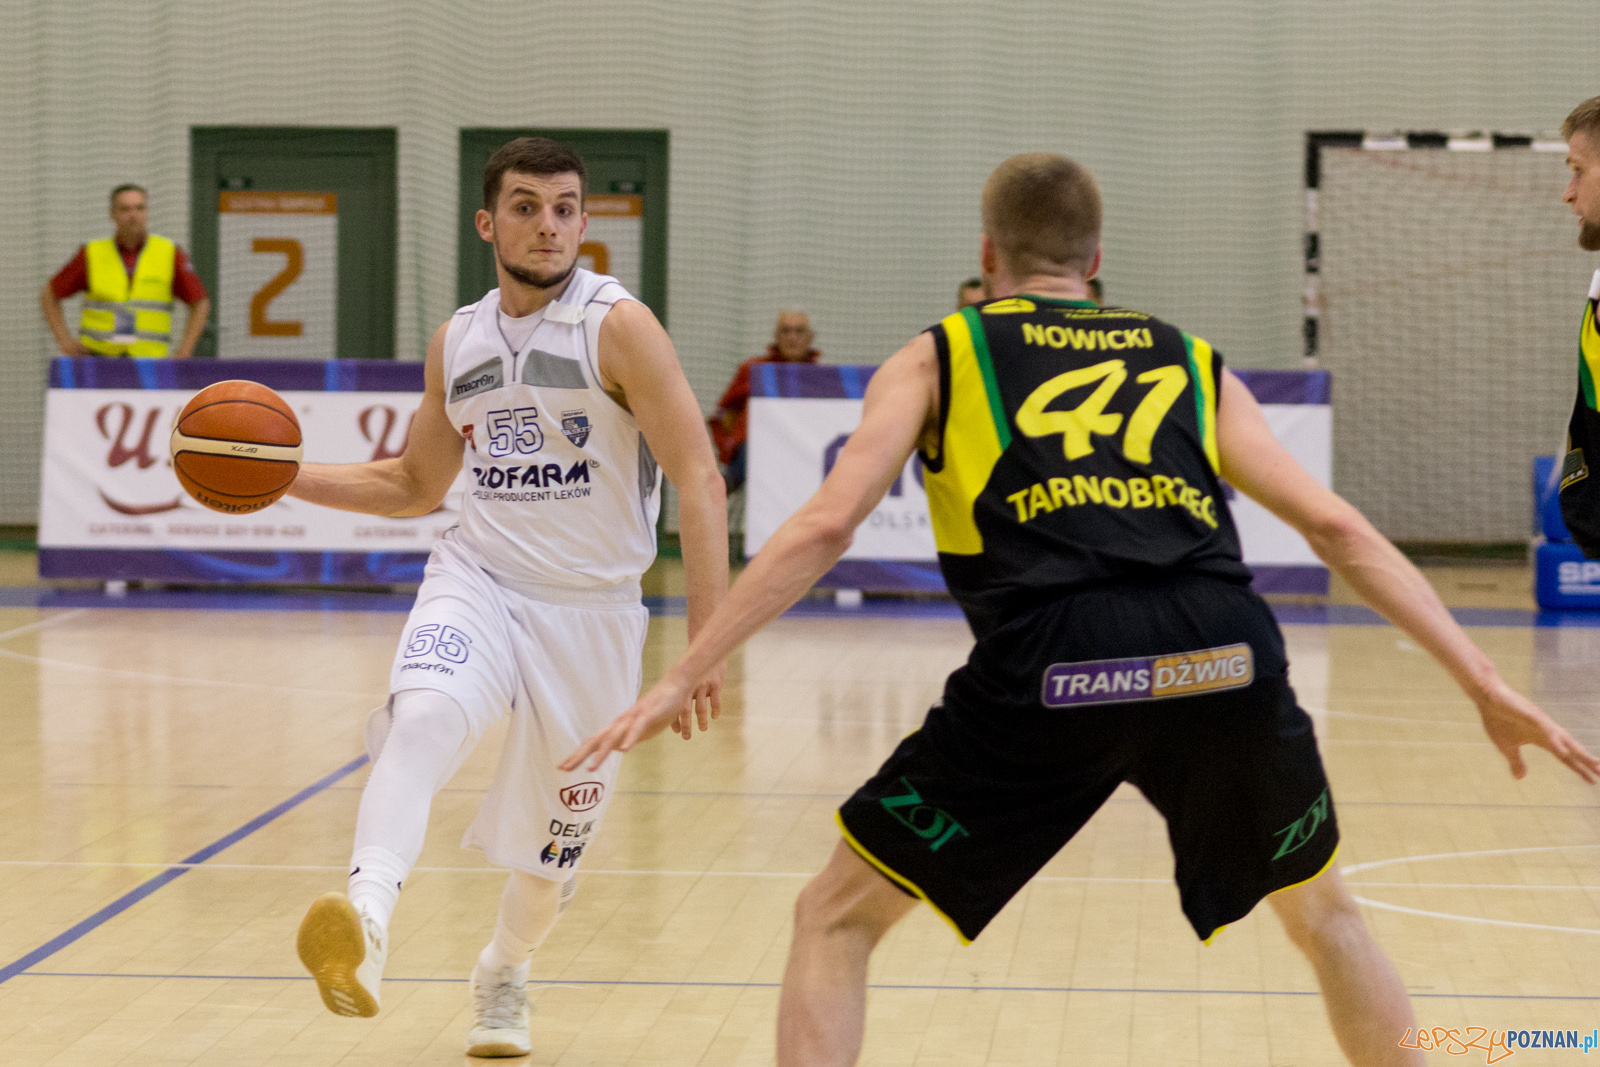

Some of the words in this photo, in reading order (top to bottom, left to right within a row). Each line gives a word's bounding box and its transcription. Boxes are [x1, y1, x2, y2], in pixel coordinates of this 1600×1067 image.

[249, 237, 305, 337] 2
[1021, 322, 1154, 351] NOWICKI
[486, 406, 544, 458] 55
[1015, 359, 1189, 465] 41
[554, 486, 592, 500] LEKÓW
[403, 623, 473, 665] 55
[568, 787, 599, 806] KIA
